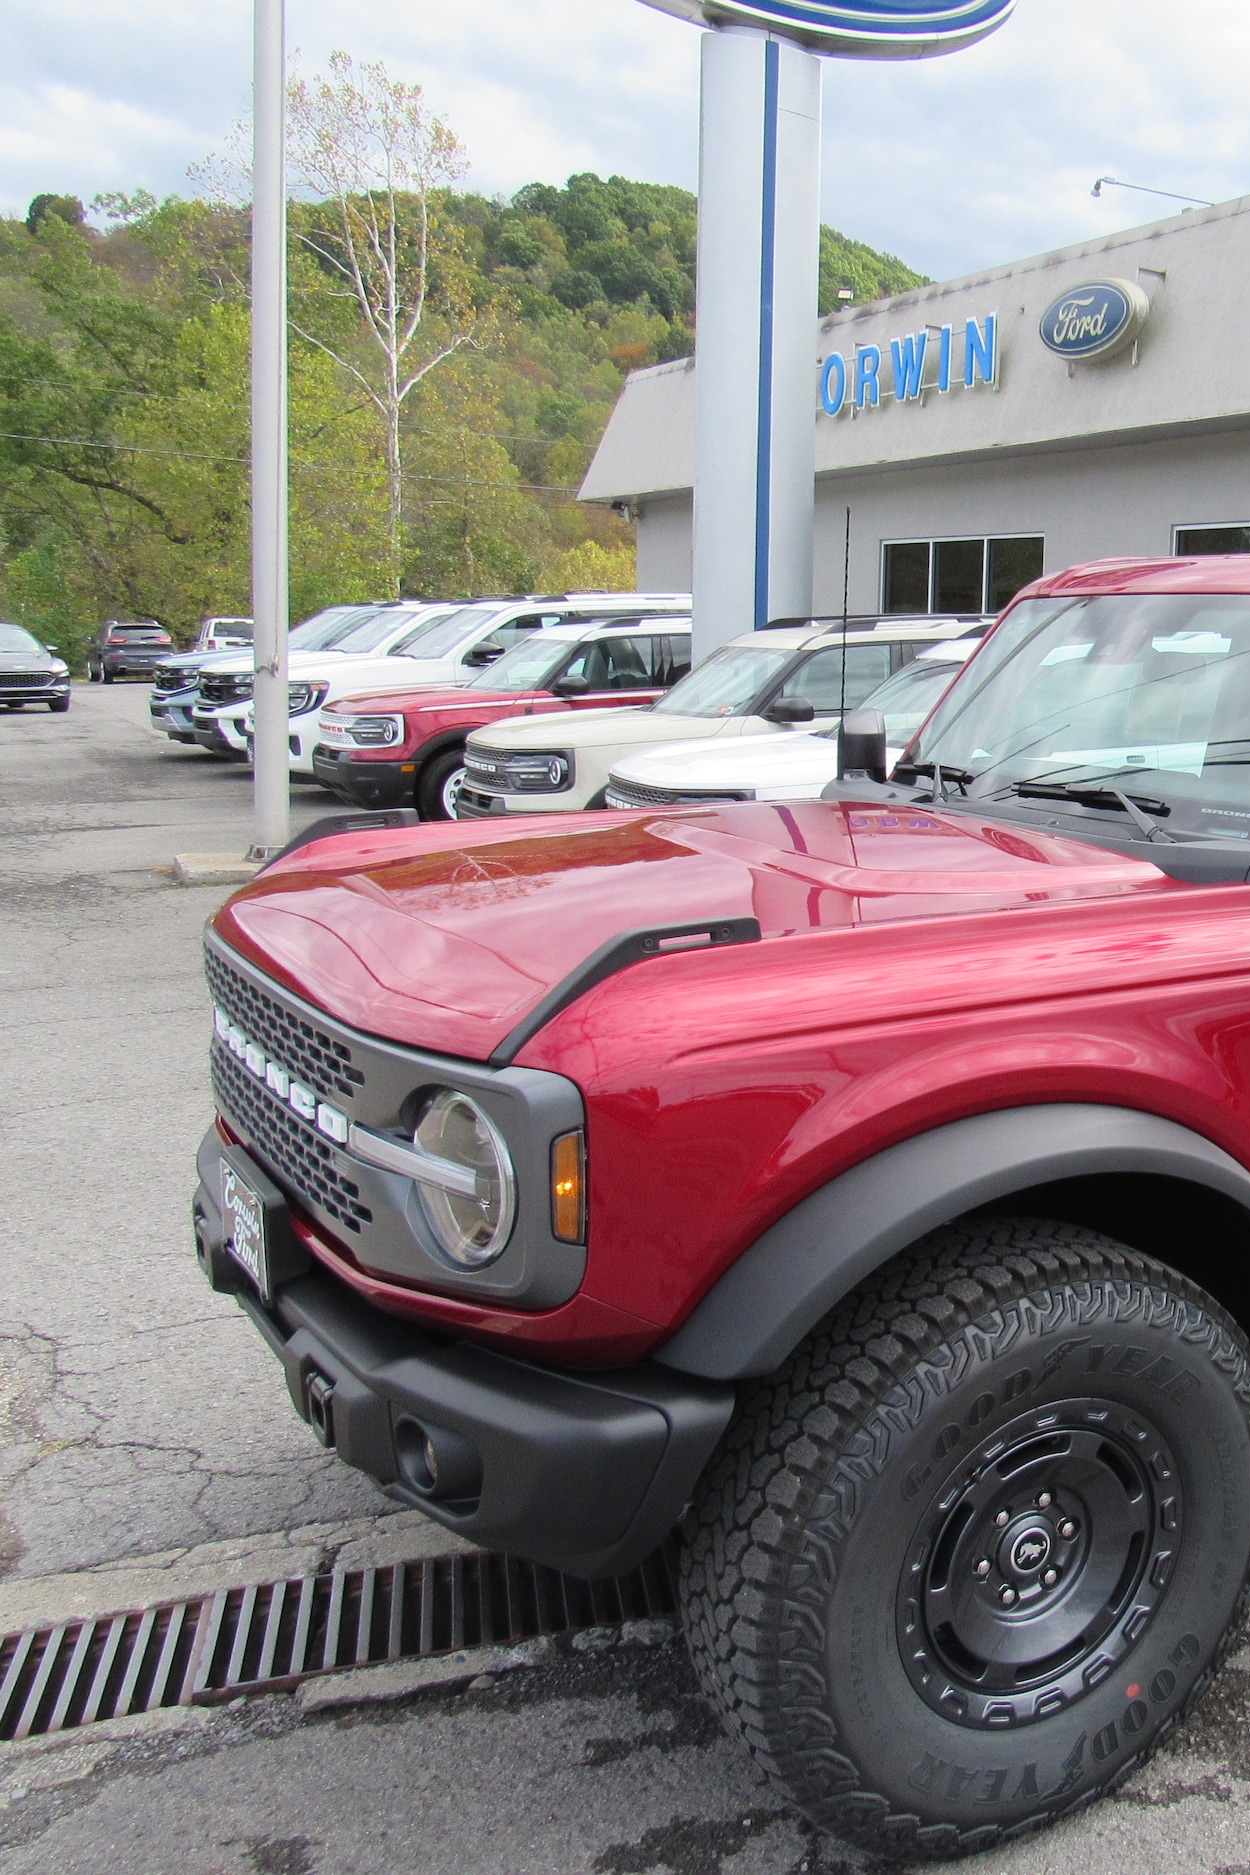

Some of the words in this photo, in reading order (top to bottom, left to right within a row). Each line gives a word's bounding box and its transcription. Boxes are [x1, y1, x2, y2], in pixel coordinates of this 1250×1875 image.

[1054, 296, 1108, 344] Ford
[214, 1006, 348, 1143] BRONCO
[233, 1215, 260, 1278] Ford
